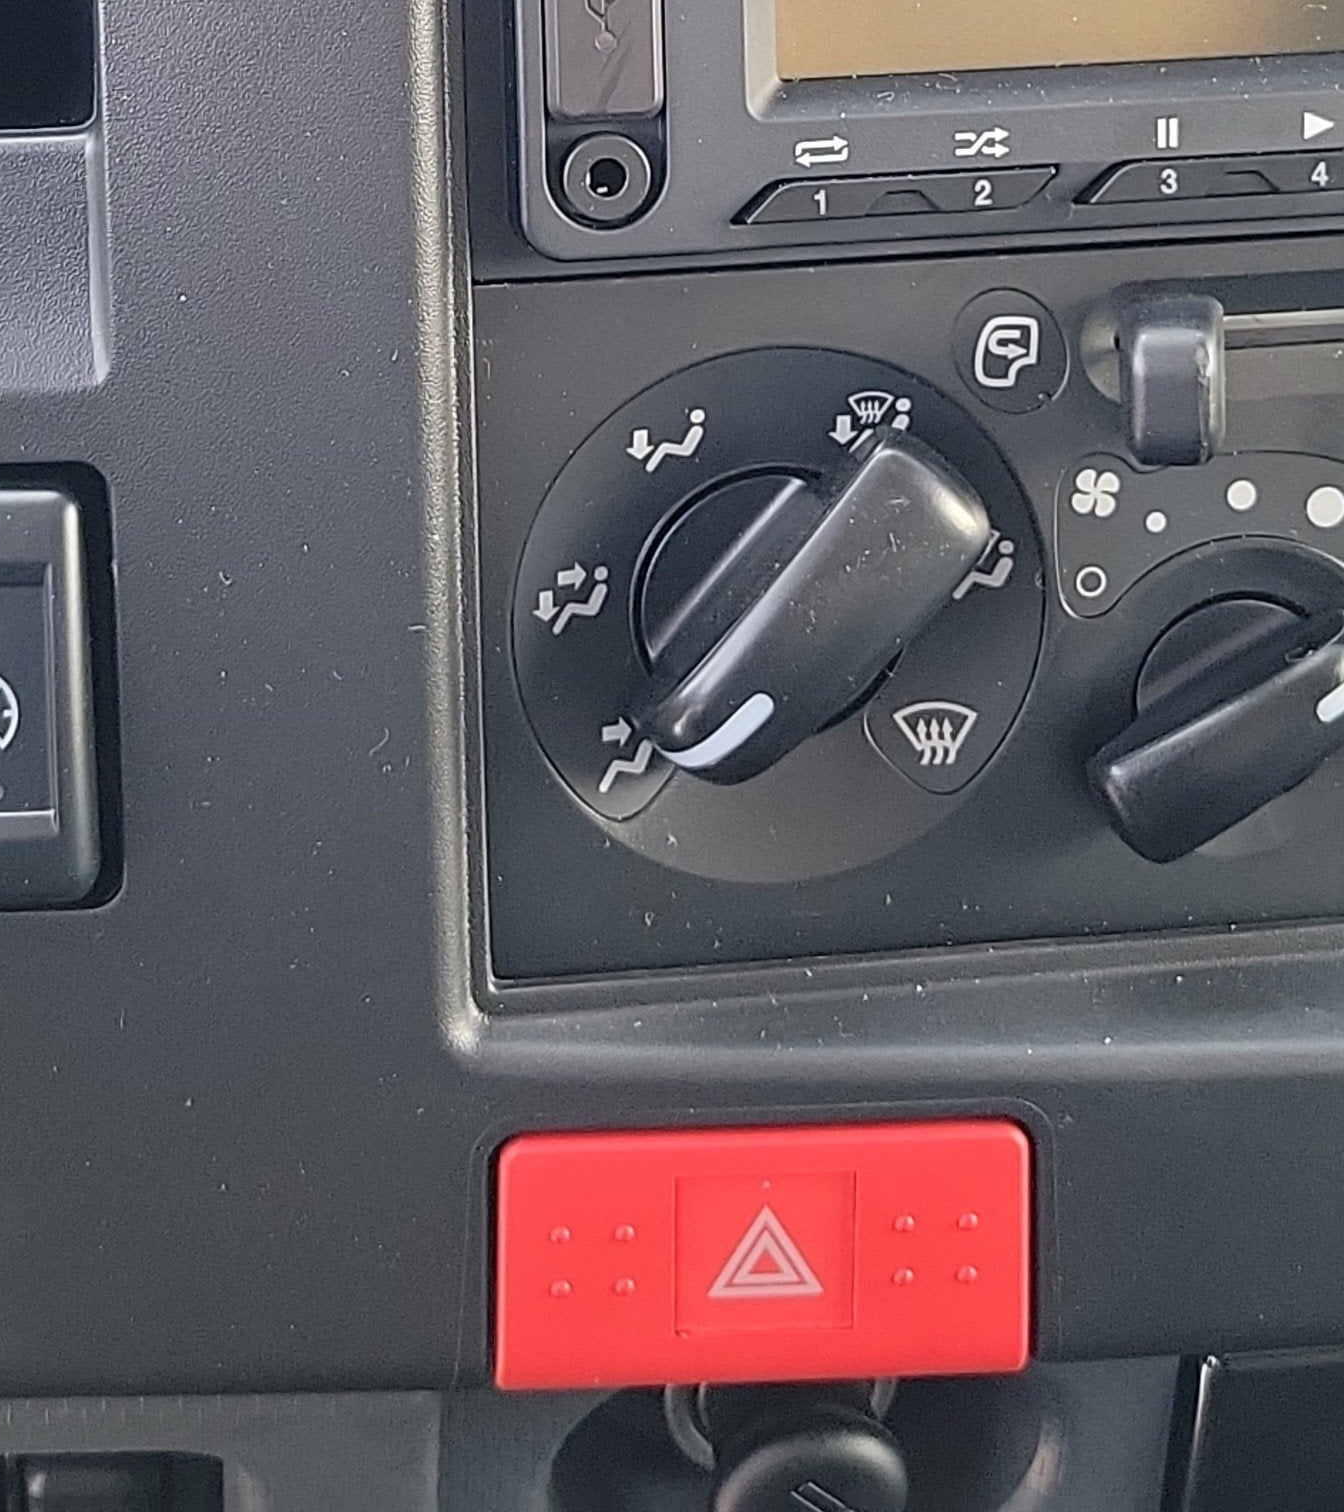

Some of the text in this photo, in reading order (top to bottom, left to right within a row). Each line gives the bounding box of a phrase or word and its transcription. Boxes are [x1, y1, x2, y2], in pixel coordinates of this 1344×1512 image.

[1160, 168, 1178, 195] 3
[1310, 162, 1329, 188] 4
[814, 190, 826, 215] 1
[973, 180, 992, 207] 2
